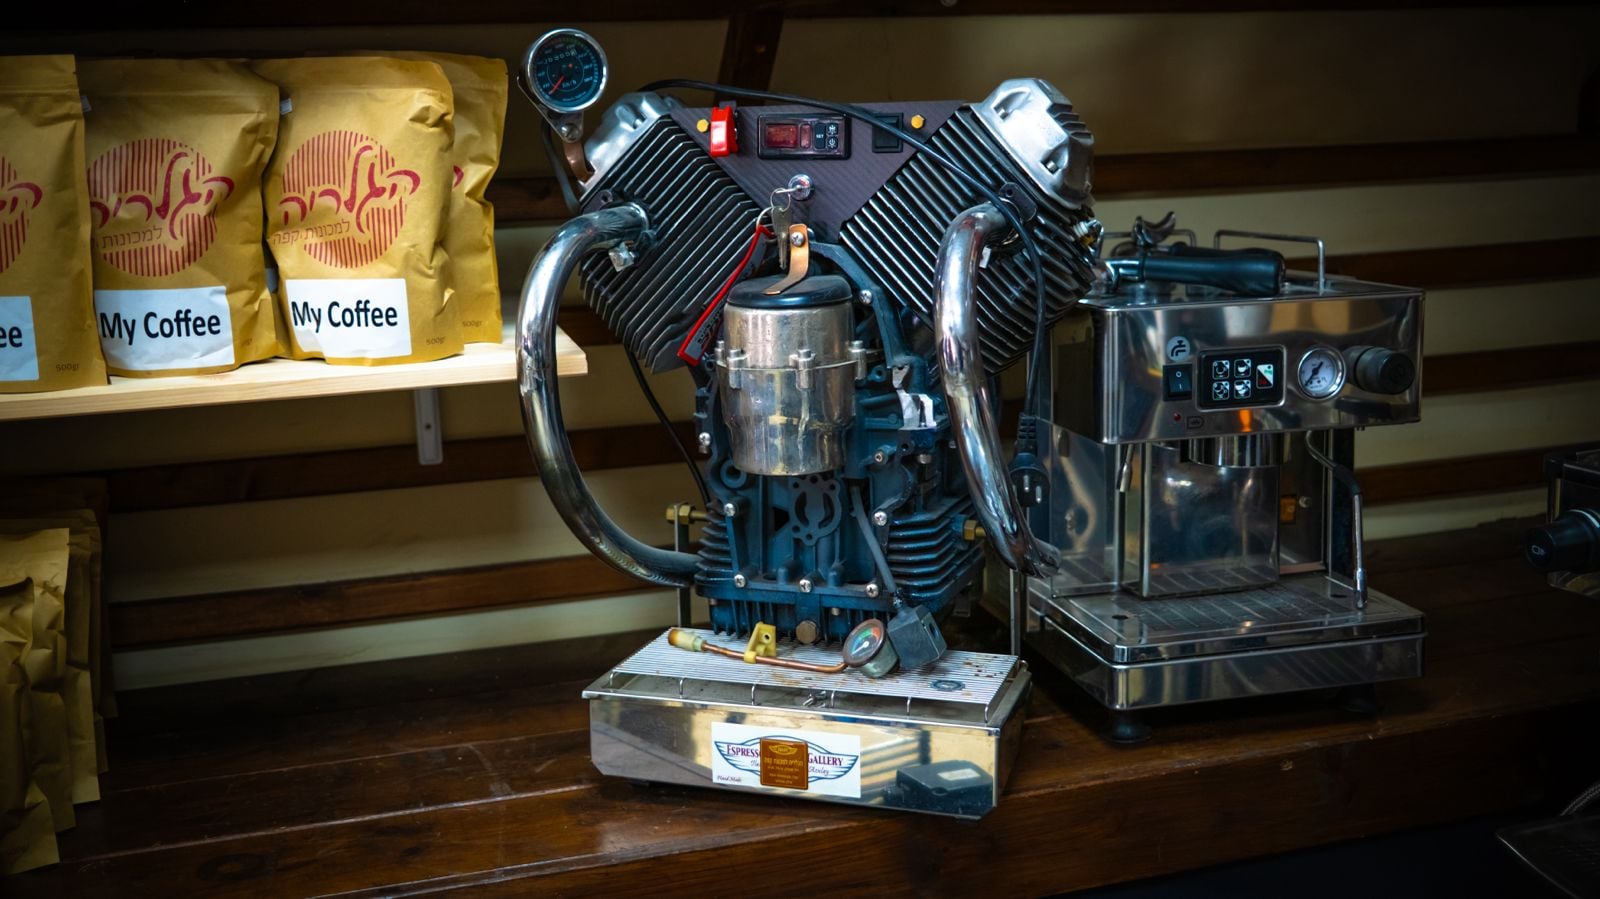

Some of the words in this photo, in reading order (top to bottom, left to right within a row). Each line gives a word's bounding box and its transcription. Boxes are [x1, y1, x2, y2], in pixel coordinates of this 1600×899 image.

[102, 226, 163, 249] למכונות
[272, 230, 300, 246] קפה
[304, 219, 350, 240] למכונות
[291, 301, 322, 333] My
[327, 299, 398, 327] Coffee
[100, 312, 136, 346] My
[143, 309, 221, 339] Coffee
[727, 744, 760, 758] ESPRESS
[808, 753, 843, 766] GALLERY
